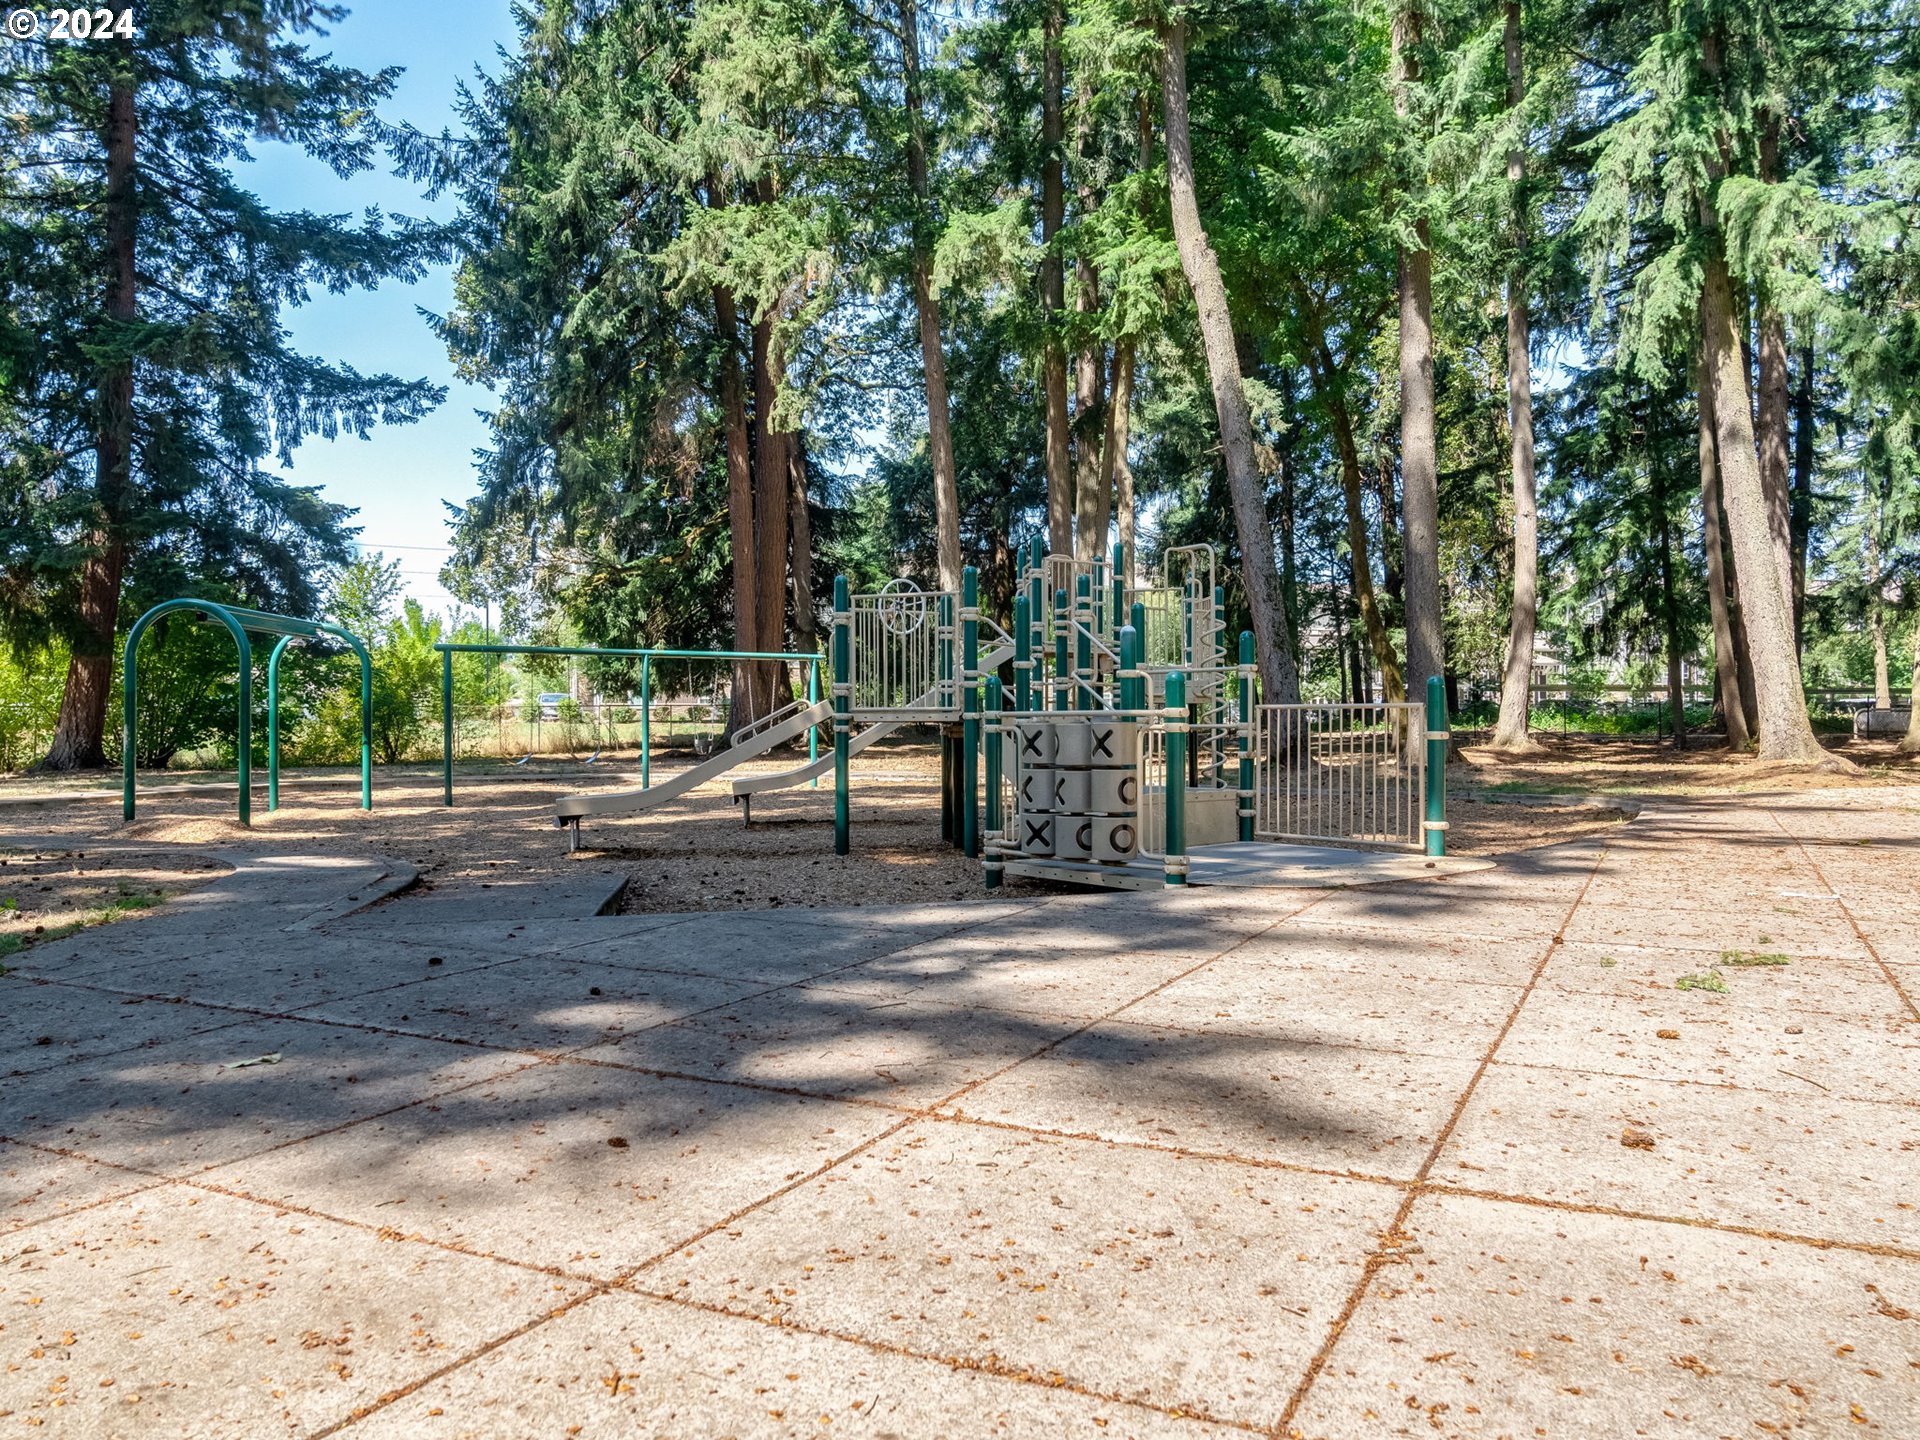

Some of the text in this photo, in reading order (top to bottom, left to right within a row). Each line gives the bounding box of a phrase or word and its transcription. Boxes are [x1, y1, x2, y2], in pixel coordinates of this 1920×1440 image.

[1022, 729, 1043, 758] X
[1091, 729, 1114, 759] X
[1026, 820, 1051, 848] X
[1109, 823, 1136, 854] O
